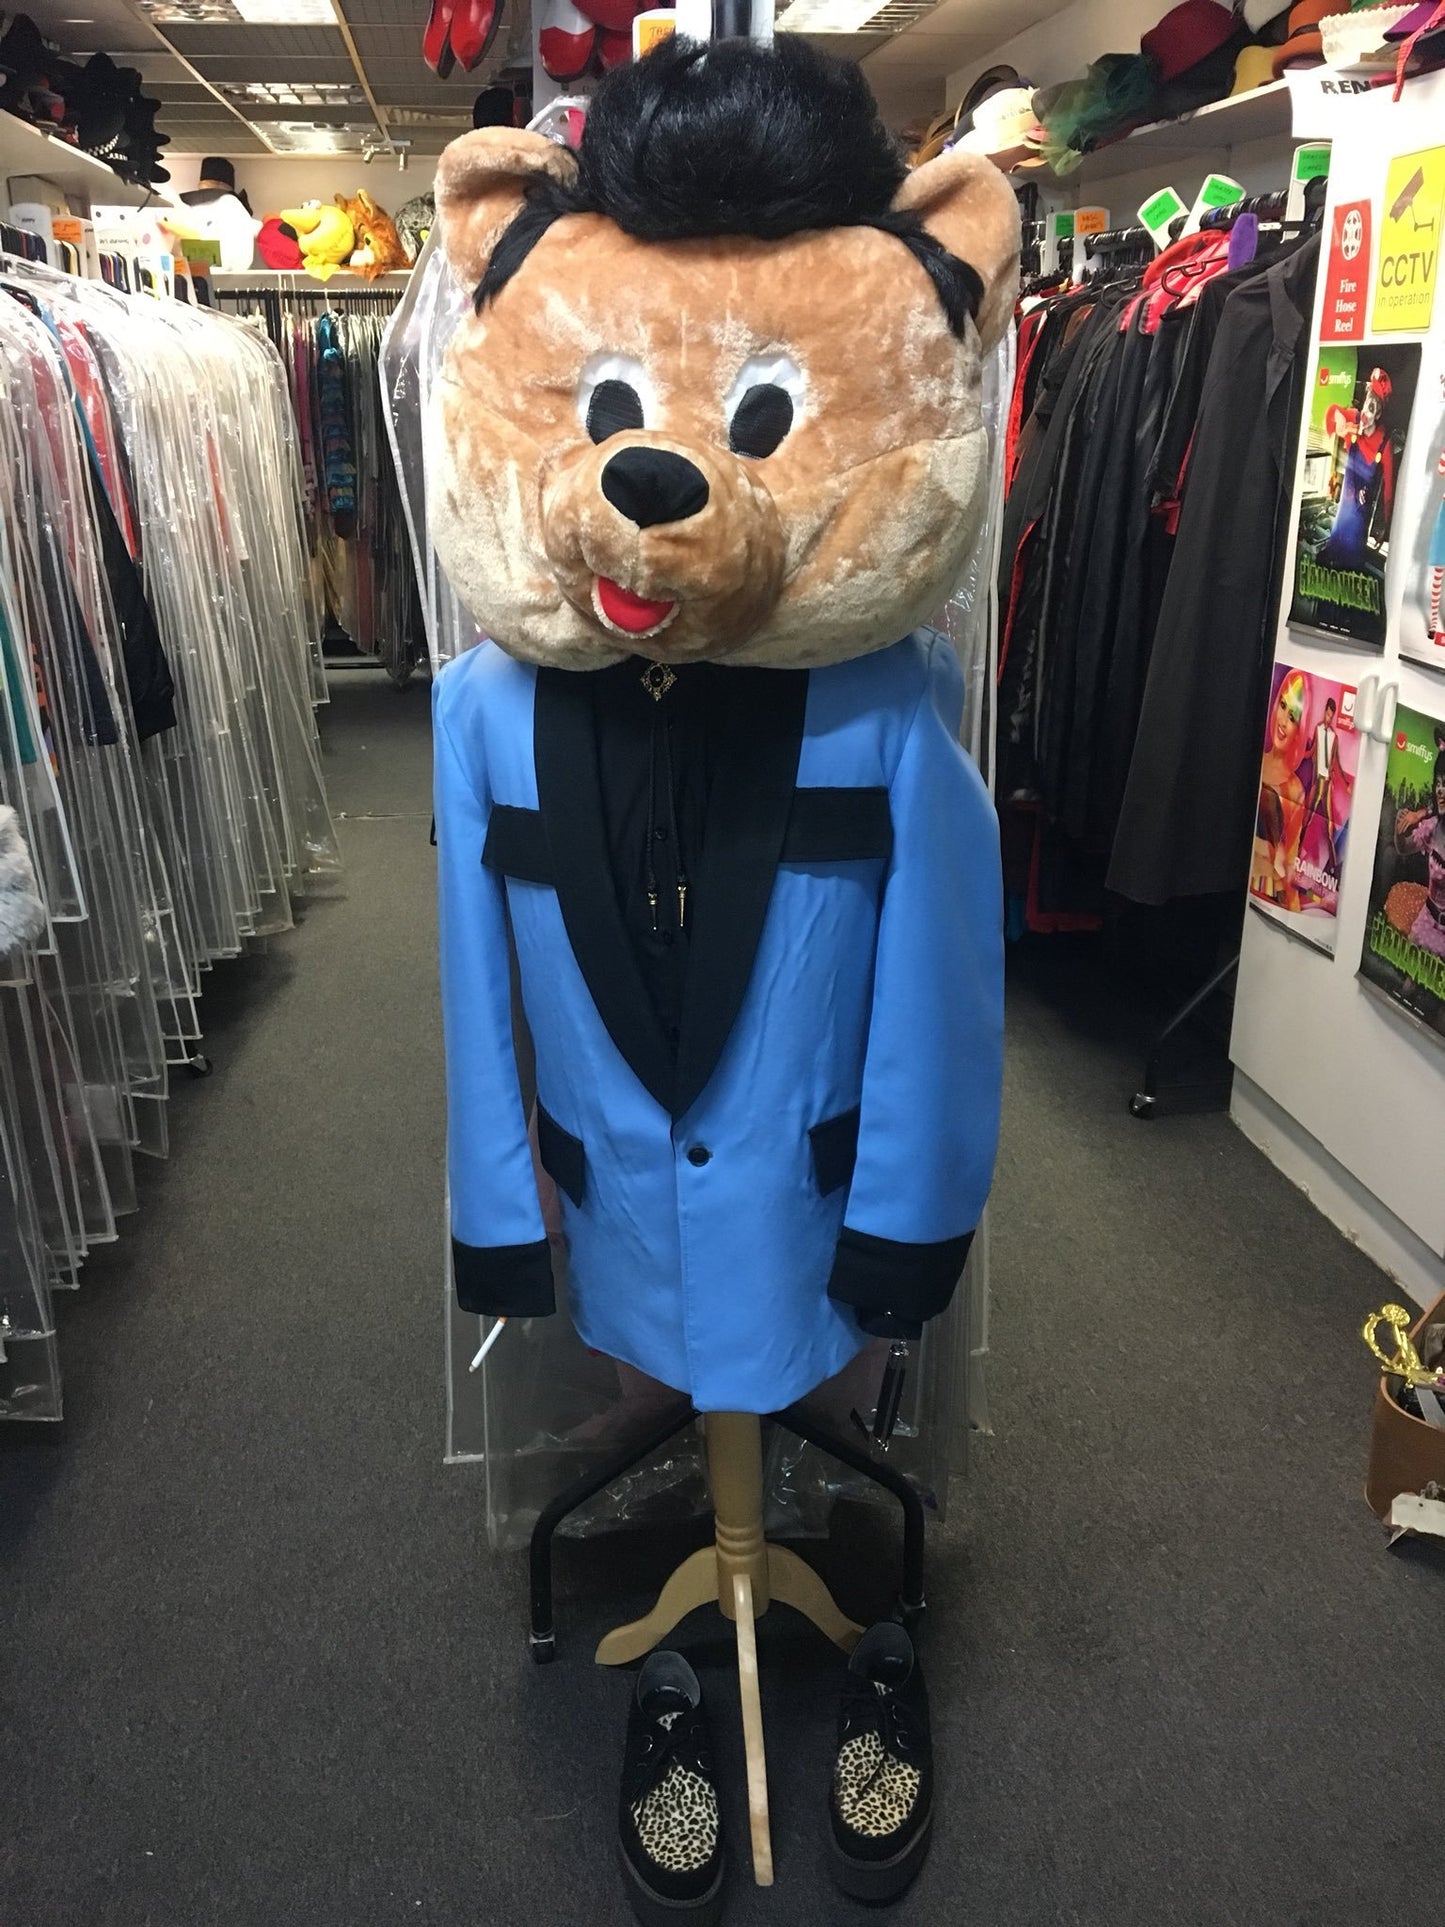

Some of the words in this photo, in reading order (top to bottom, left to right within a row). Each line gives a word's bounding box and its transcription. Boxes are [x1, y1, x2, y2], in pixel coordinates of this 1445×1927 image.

[1381, 250, 1436, 288] CCTV
[1339, 279, 1357, 293] Fire
[1335, 299, 1357, 313] Hose
[1378, 296, 1387, 307] in
[1387, 291, 1431, 308] operation
[1334, 317, 1354, 333] Reel
[1329, 371, 1353, 389] smiffys
[1298, 556, 1381, 616] HALLOWEEN
[1406, 741, 1434, 764] smiffys
[1293, 856, 1339, 894] RAINBOW
